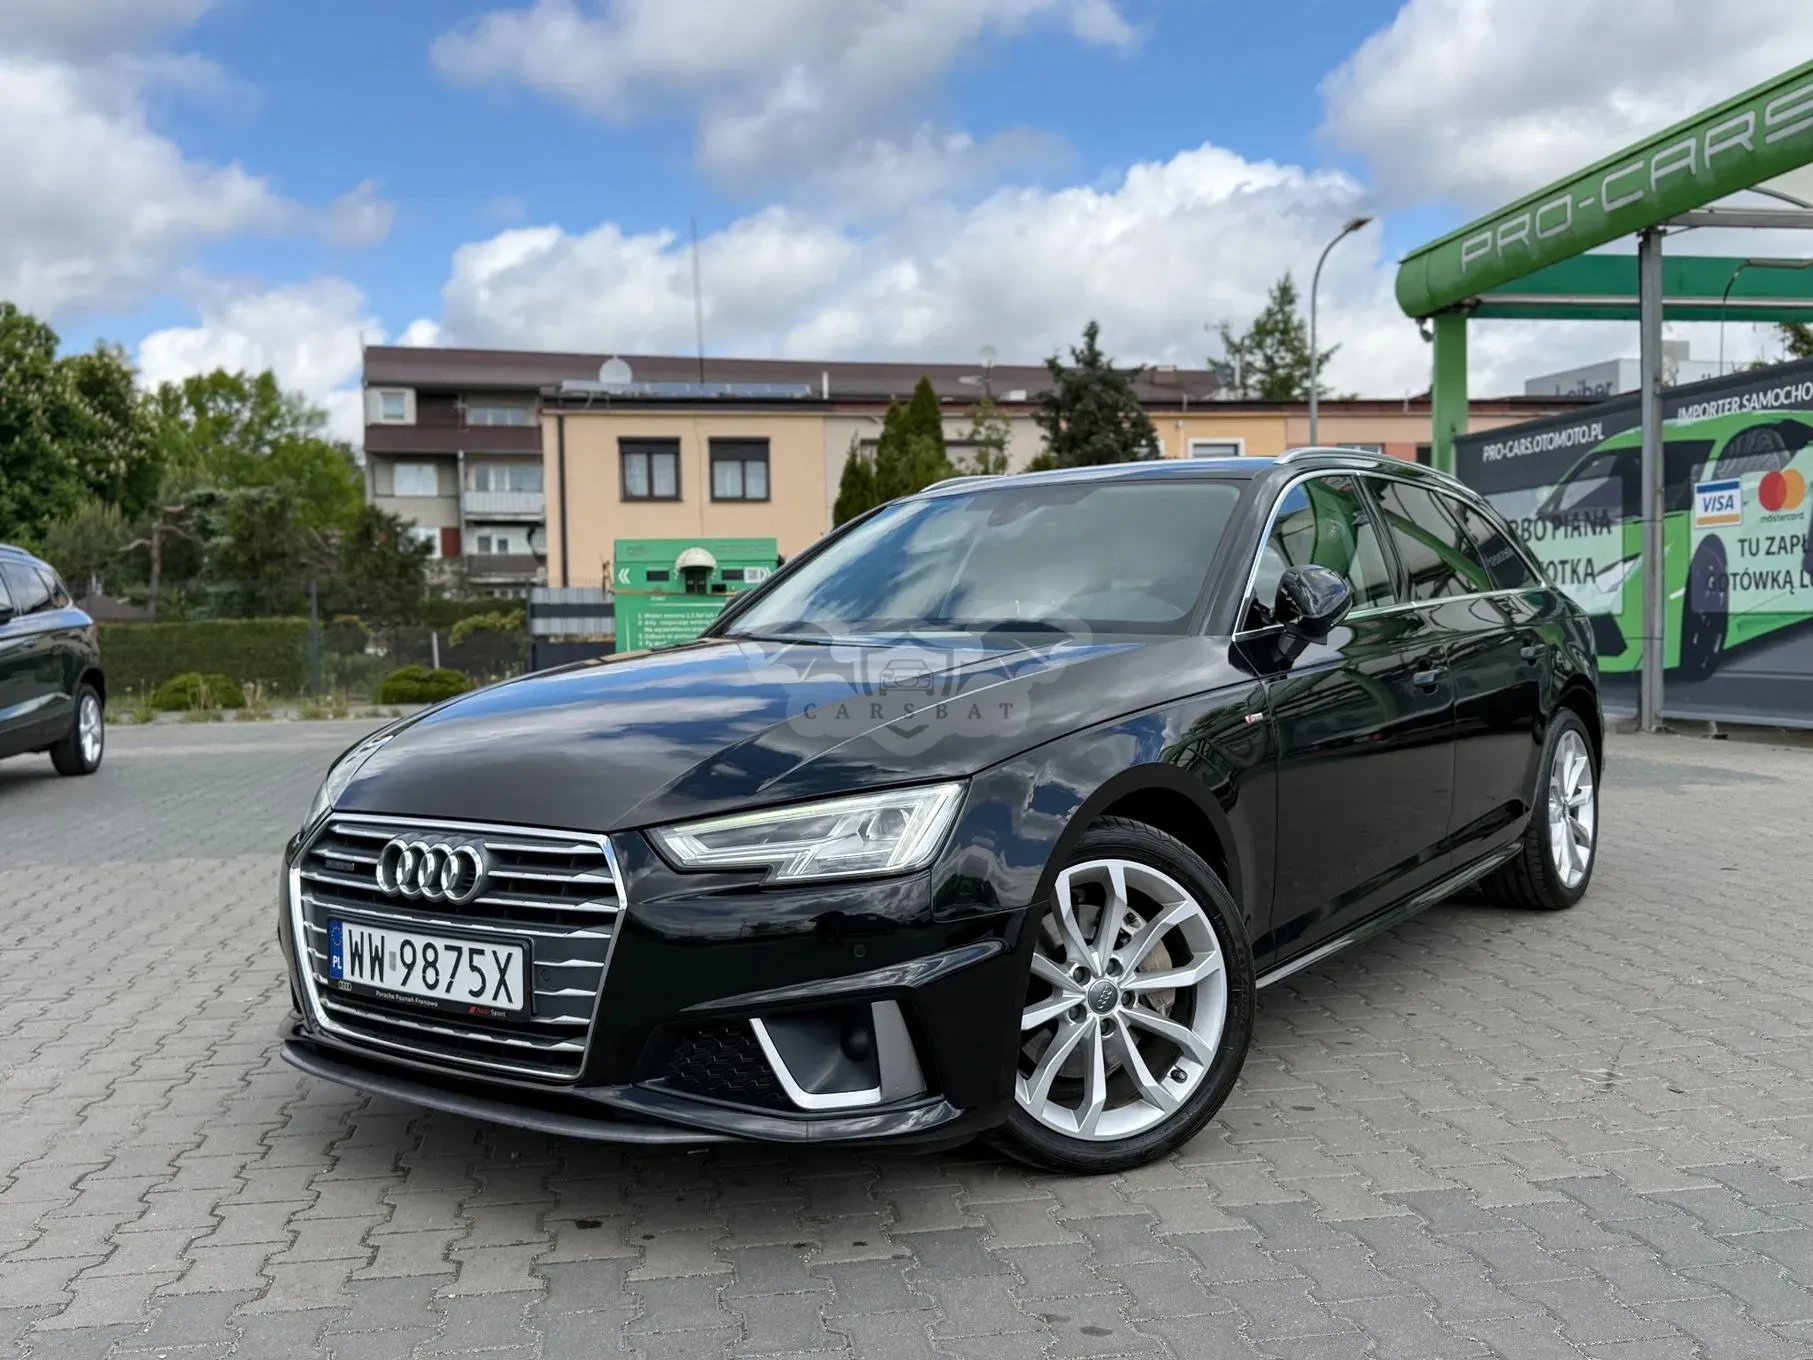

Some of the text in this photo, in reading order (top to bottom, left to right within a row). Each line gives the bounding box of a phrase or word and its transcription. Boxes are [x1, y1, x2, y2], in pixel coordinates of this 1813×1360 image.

[1461, 84, 1813, 273] PRO-CARS
[1677, 396, 1740, 420] IMPORTER
[1483, 422, 1605, 462] PRO-CARS.OTOMOTO.PL
[1703, 494, 1735, 512] VISA
[1552, 508, 1612, 540] PIANA
[1760, 511, 1804, 523] mastercard
[1738, 537, 1760, 557] TU
[332, 928, 514, 1004] PL WW 9875X
[490, 1007, 506, 1018] Sport
